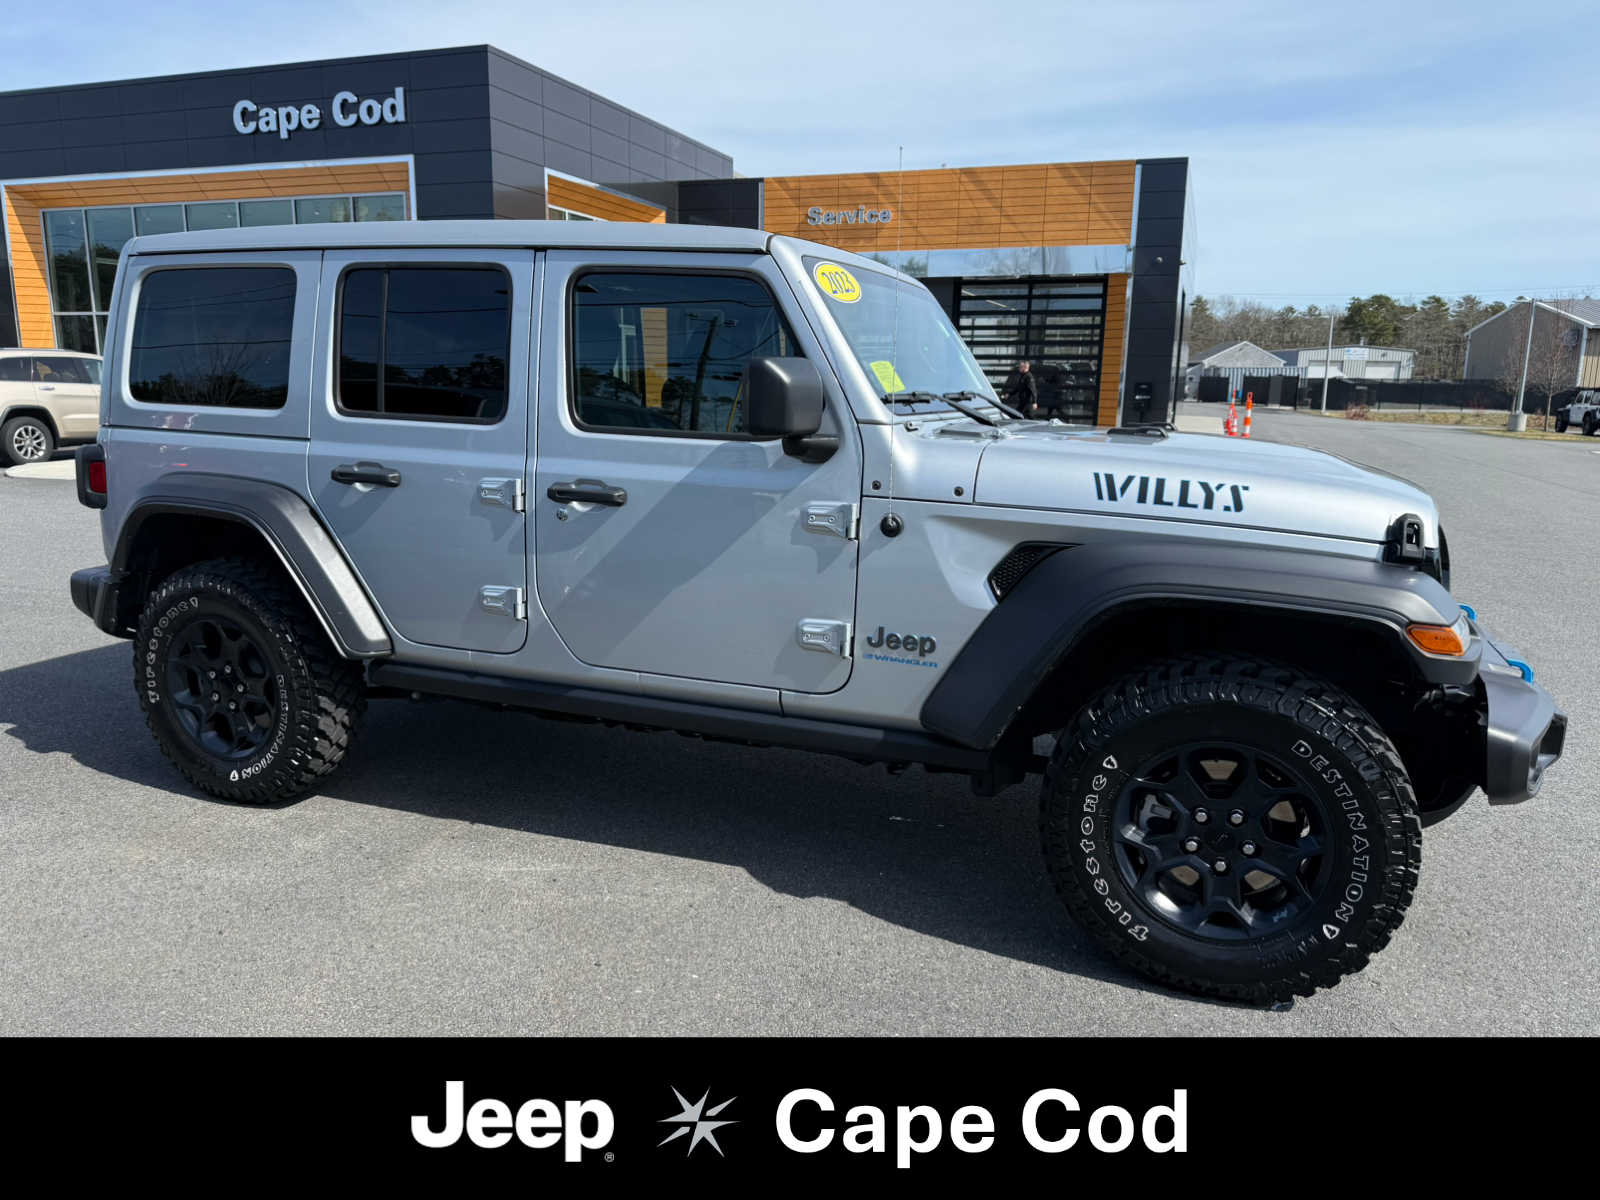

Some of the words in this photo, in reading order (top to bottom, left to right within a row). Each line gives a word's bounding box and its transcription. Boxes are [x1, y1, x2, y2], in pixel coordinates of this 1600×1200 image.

[232, 99, 321, 139] Cape
[331, 86, 407, 128] Cod
[807, 206, 892, 226] Service
[821, 270, 856, 294] 2023
[1092, 471, 1250, 513] WILLYS
[866, 626, 937, 657] Jeep
[1291, 739, 1371, 924] DESTINATION
